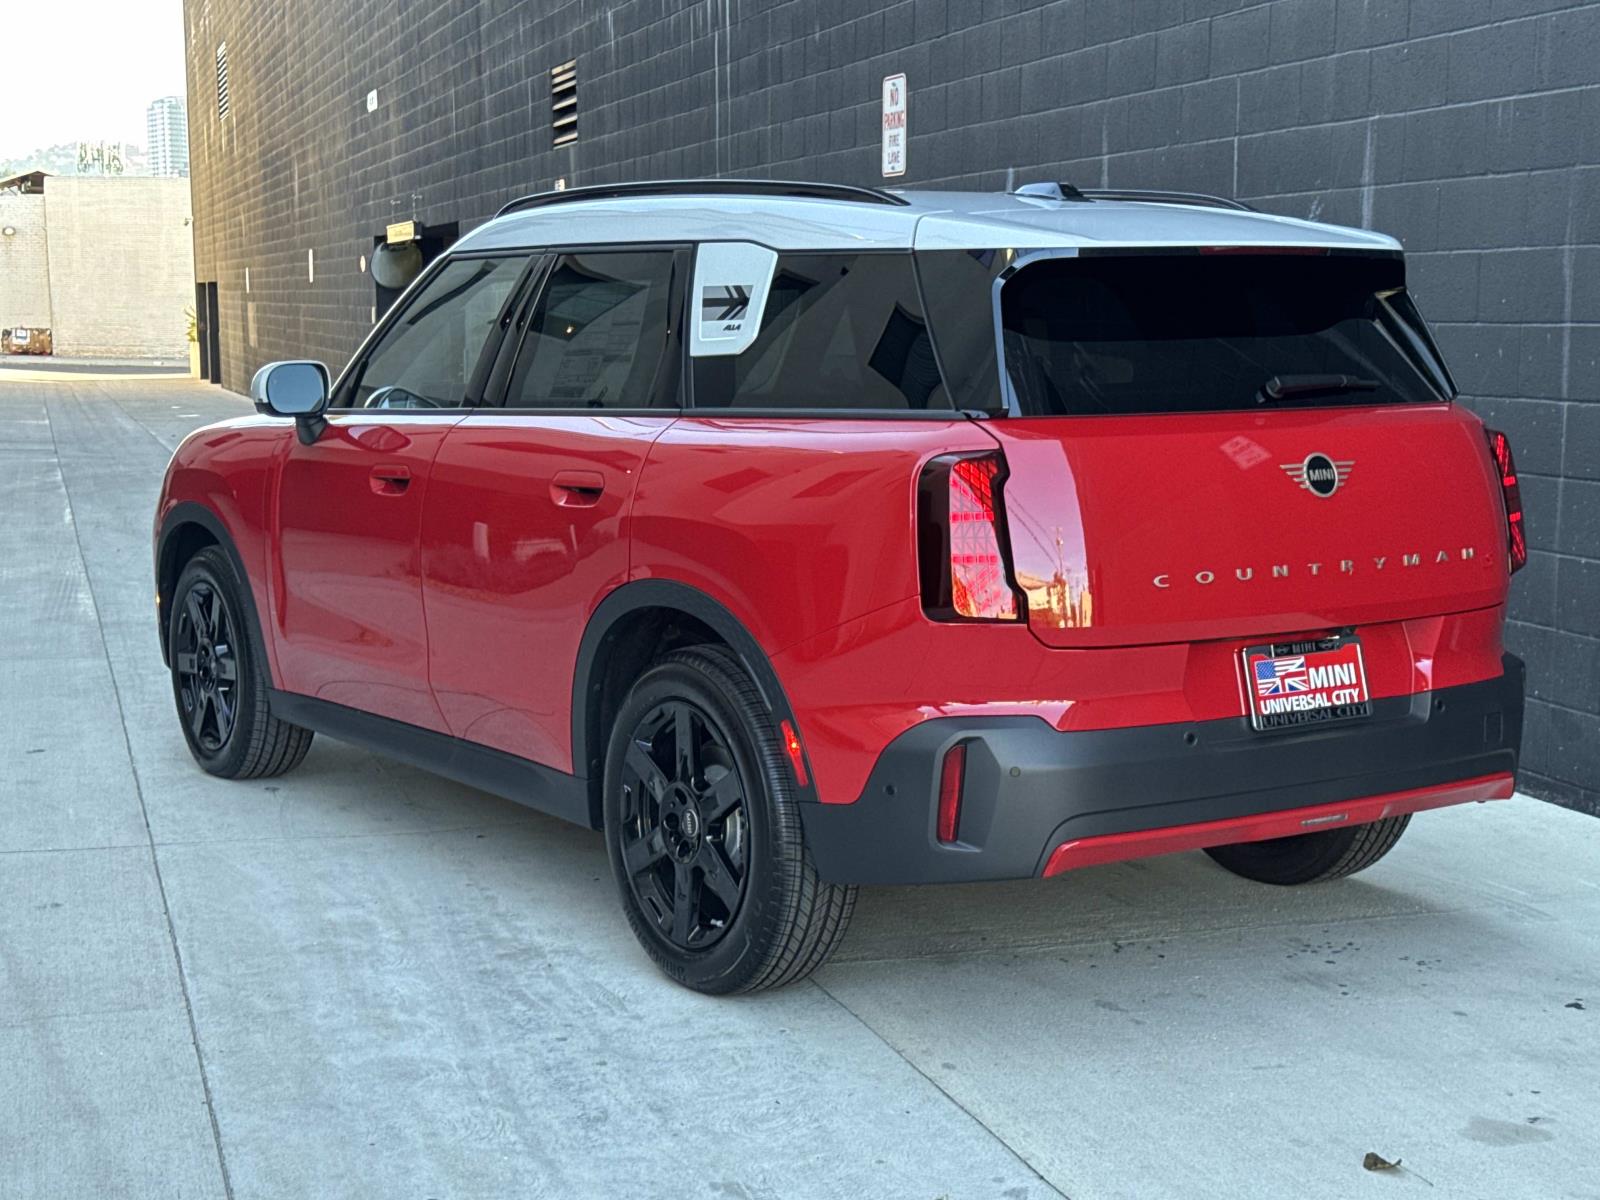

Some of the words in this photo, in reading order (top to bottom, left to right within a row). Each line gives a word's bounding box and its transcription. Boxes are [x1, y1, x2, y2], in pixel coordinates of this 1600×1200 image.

[889, 87, 899, 107] NO
[884, 110, 905, 130] PARKING
[888, 151, 900, 165] LANE
[1309, 468, 1334, 481] MINI
[1153, 546, 1474, 588] COUNTRYMAN
[1292, 641, 1316, 653] MINI
[1308, 662, 1357, 690] MINI
[1260, 691, 1331, 715] UNIVERSAL
[1331, 688, 1360, 705] CITY
[1263, 708, 1332, 728] UNIVERSAL
[1337, 703, 1367, 717] CITY
